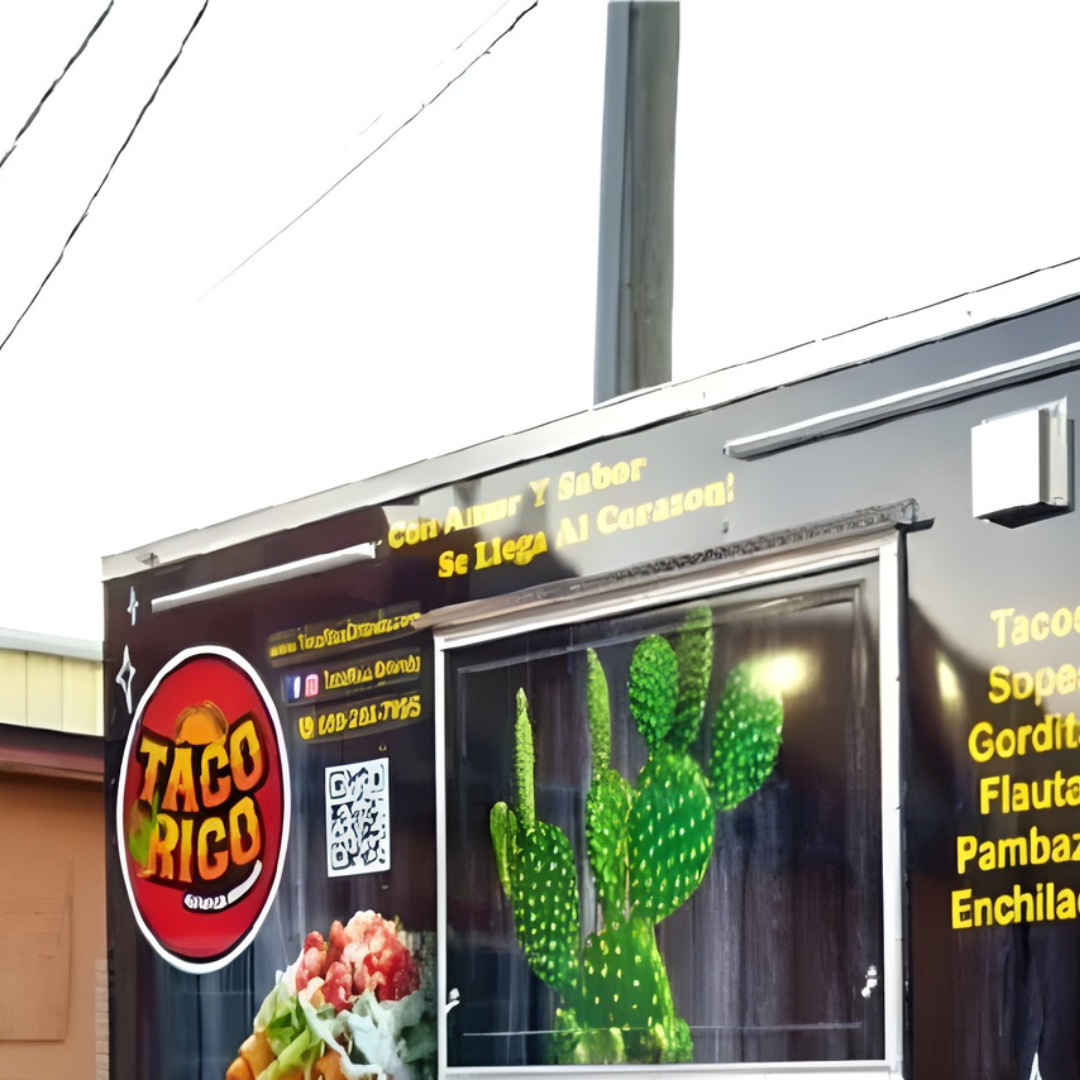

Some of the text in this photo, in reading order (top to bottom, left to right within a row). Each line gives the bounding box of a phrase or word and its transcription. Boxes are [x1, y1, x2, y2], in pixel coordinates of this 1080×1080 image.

[387, 516, 441, 550] Con
[530, 478, 550, 507] Y
[558, 457, 648, 501] Sabor
[438, 550, 468, 578] Se
[474, 530, 549, 570] Llega
[556, 514, 589, 549] Al
[140, 719, 262, 812] TACO
[138, 796, 263, 883] RICO
